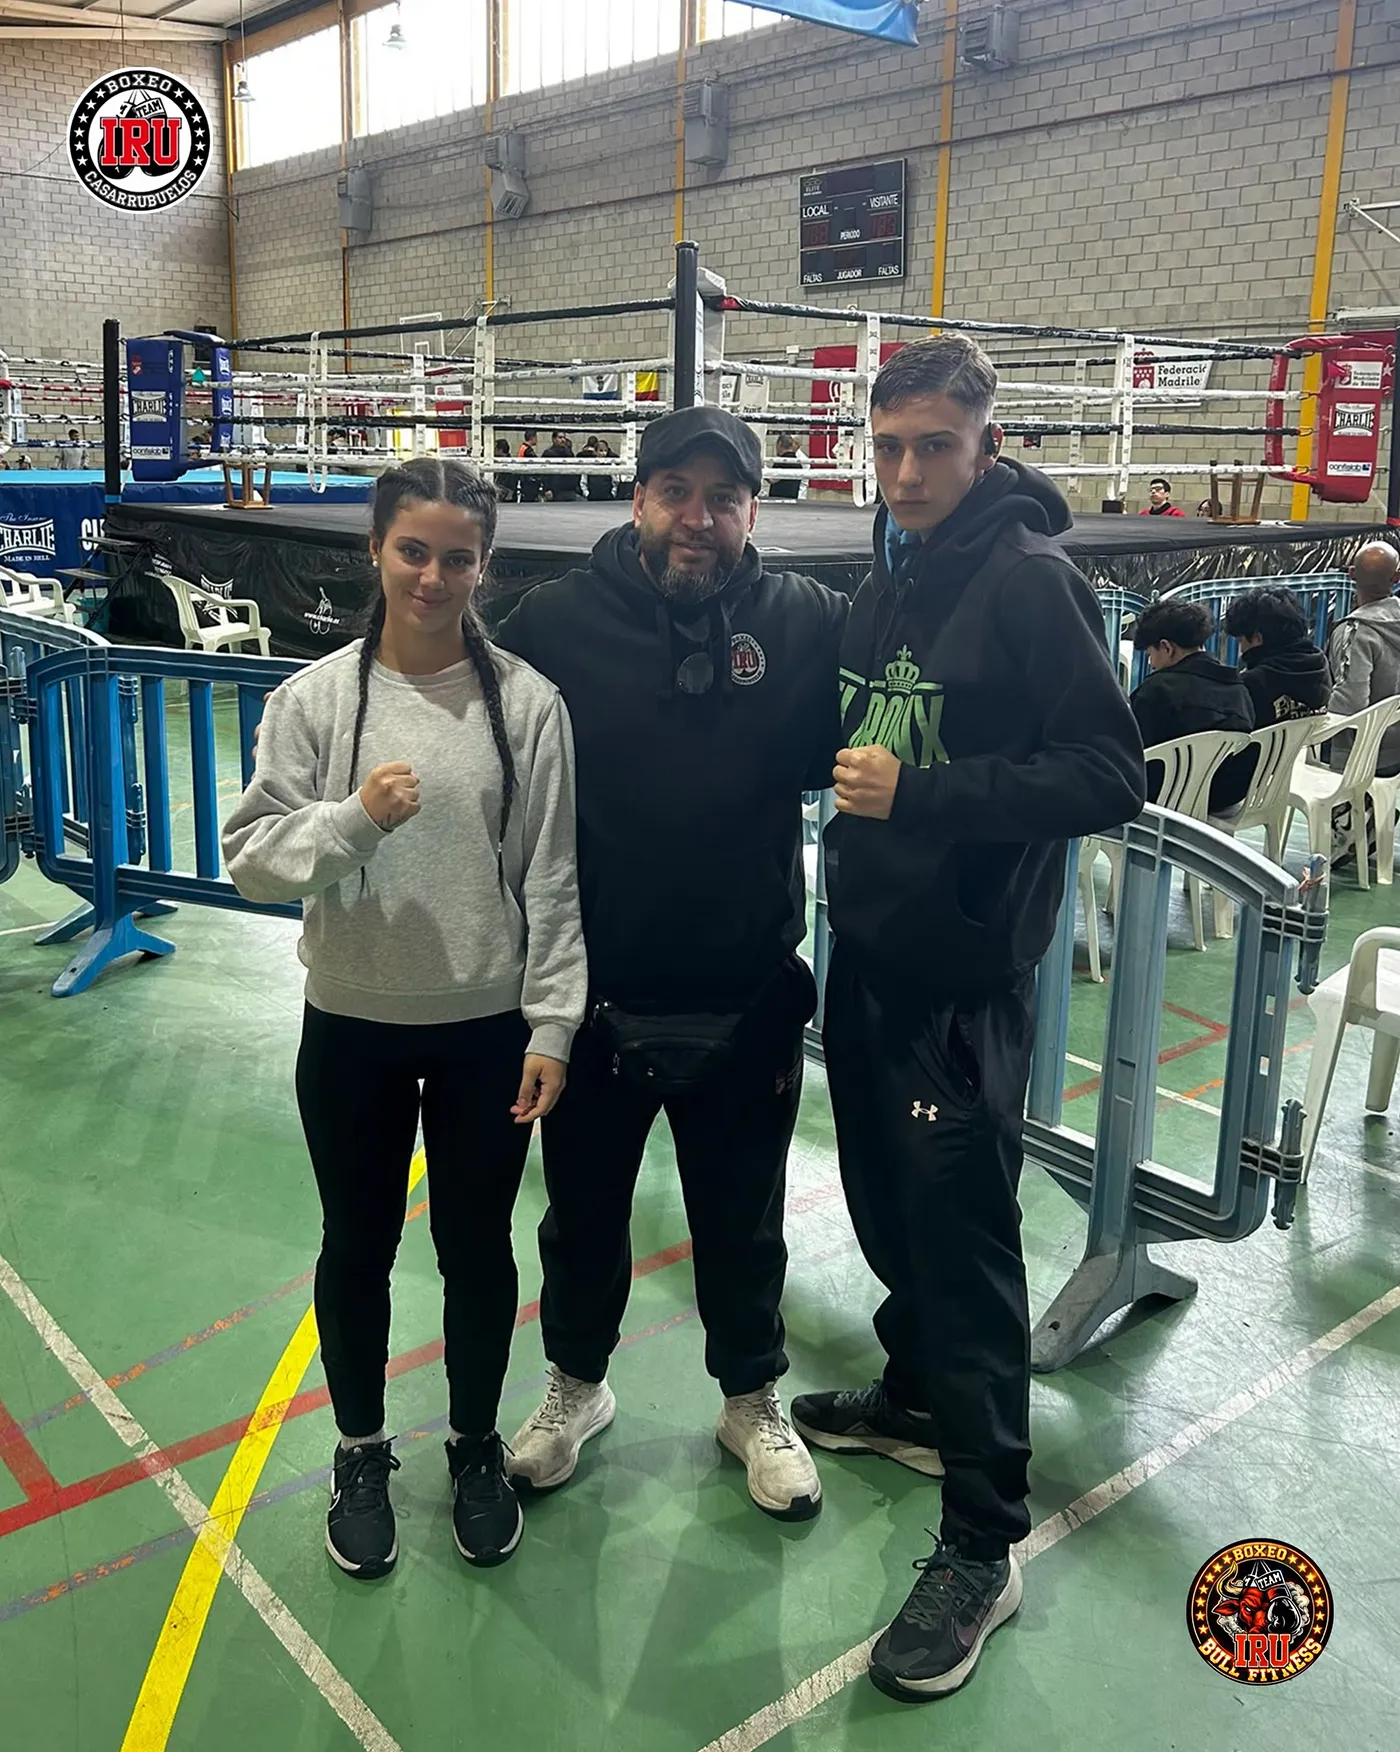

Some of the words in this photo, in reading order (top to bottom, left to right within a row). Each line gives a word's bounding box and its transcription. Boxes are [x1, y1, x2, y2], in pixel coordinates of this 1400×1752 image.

[802, 205, 829, 218] LOCAL
[840, 229, 860, 240] PERIODO
[837, 269, 862, 280] JUGADOR
[878, 265, 900, 275] FALTAS
[803, 273, 822, 283] FALTAS
[1158, 376, 1202, 387] Madrile
[1334, 411, 1375, 430] CHARLIE
